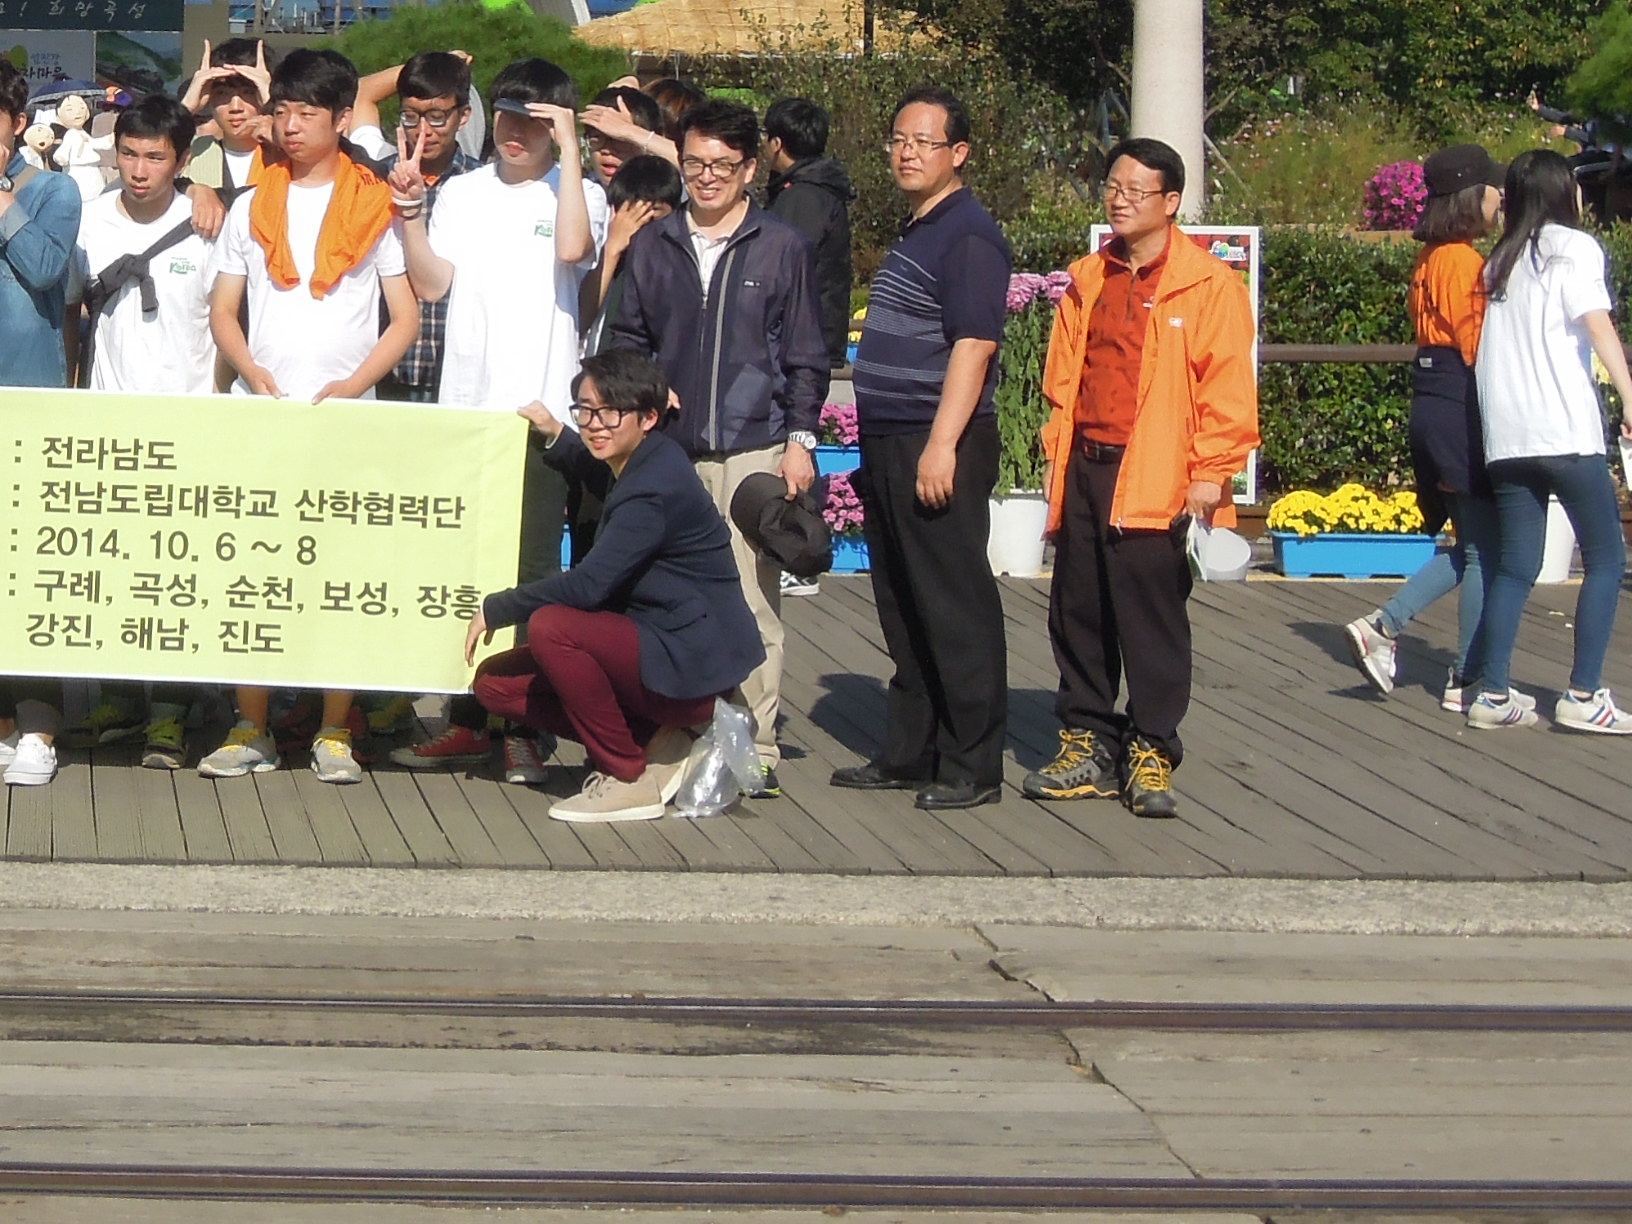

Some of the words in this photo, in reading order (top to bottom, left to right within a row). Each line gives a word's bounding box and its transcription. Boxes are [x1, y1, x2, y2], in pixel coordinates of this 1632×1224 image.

[169, 262, 197, 274] Korea
[42, 436, 177, 471] 전라남도
[40, 480, 279, 519] 전남도립대학교
[294, 489, 466, 529] 산학협력단
[36, 526, 130, 560] 2014.
[150, 530, 199, 562] 10.
[215, 532, 236, 562] 6
[296, 535, 317, 566] 8
[34, 570, 113, 606] 구례,
[129, 572, 209, 609] 곡성,
[225, 575, 304, 614] 순천,
[320, 581, 399, 618] 보성,
[417, 584, 481, 621] 장흥
[26, 613, 103, 650] 강진,
[120, 617, 199, 654] 해남,
[218, 620, 284, 654] 진도
